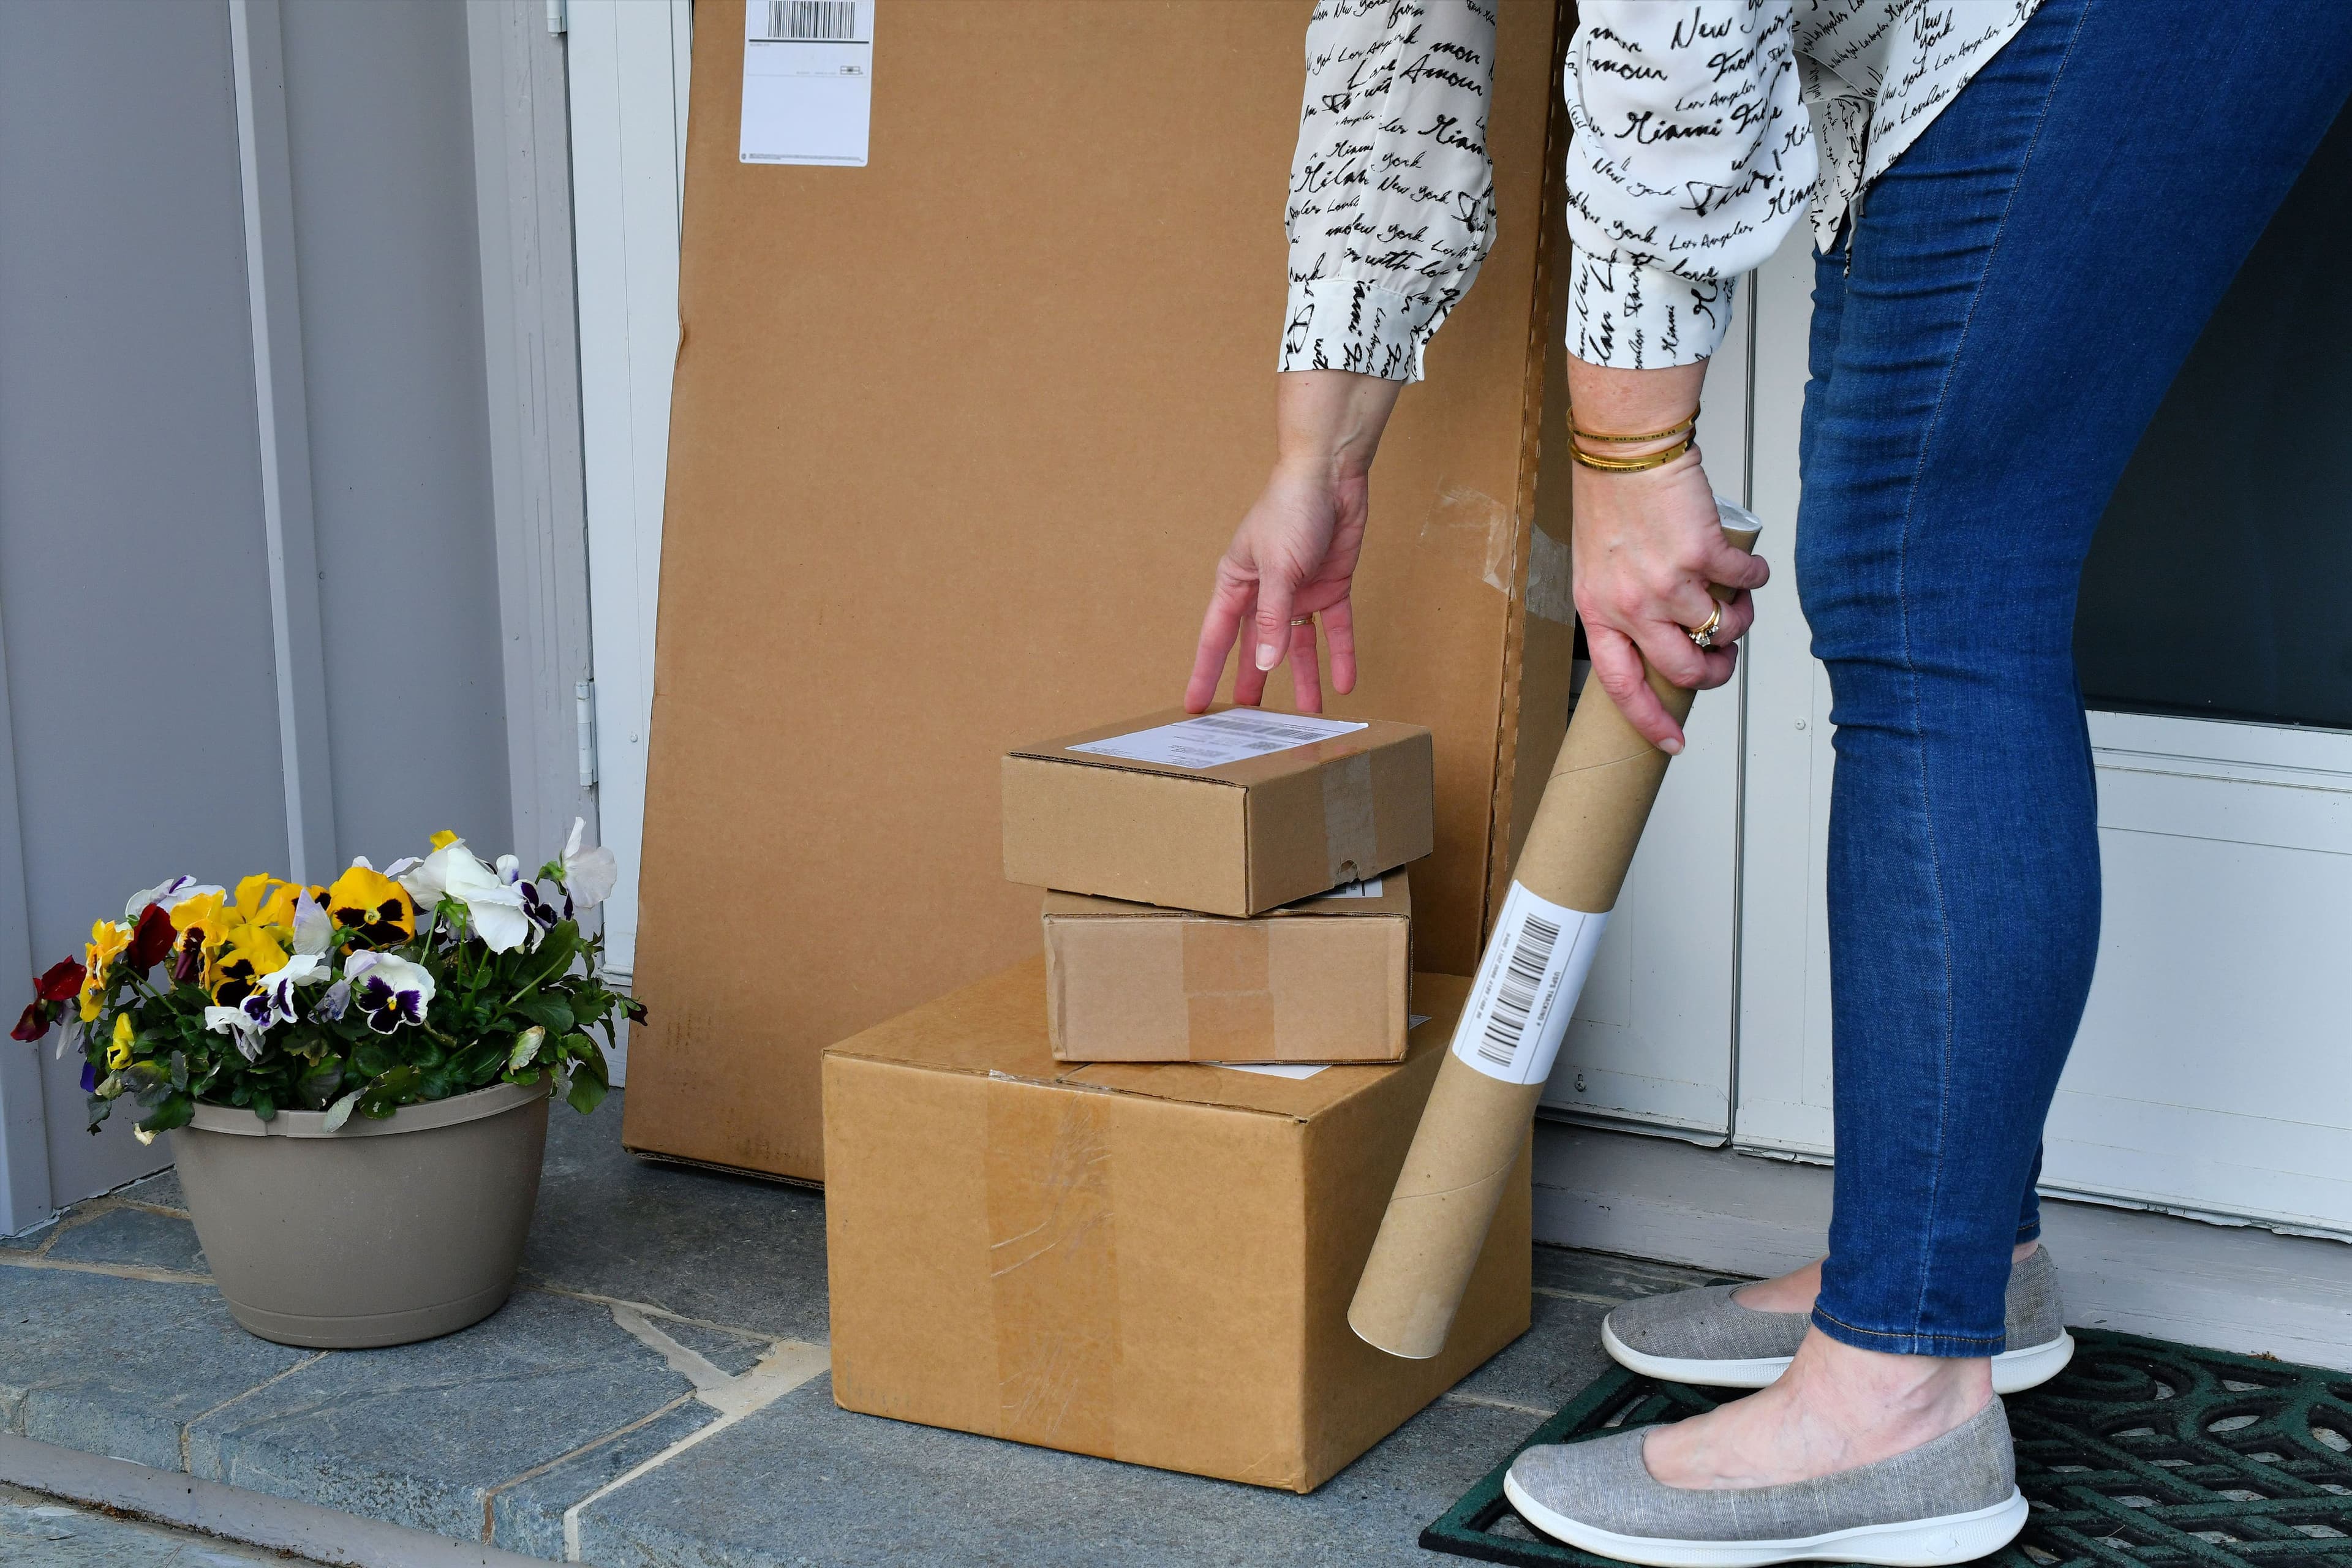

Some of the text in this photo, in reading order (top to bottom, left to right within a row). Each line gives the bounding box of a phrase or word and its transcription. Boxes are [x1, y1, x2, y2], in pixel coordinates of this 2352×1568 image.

[1670, 6, 1733, 50] New
[1912, 7, 1956, 64] York
[1913, 6, 1943, 43] New
[1958, 24, 2001, 57] Angeles
[1400, 53, 1483, 97] Amour
[1901, 83, 1951, 124] London
[1615, 111, 1724, 145] Miami
[1294, 156, 1370, 194] Milan
[1371, 150, 1427, 173] York
[1593, 157, 1627, 184] New
[1377, 175, 1453, 205] New York
[1376, 224, 1430, 243] York
[1604, 220, 1659, 246] York
[1700, 221, 1754, 249] Angeles
[1549, 971, 1561, 989] USPS
[1537, 990, 1555, 1021] TRACKING
